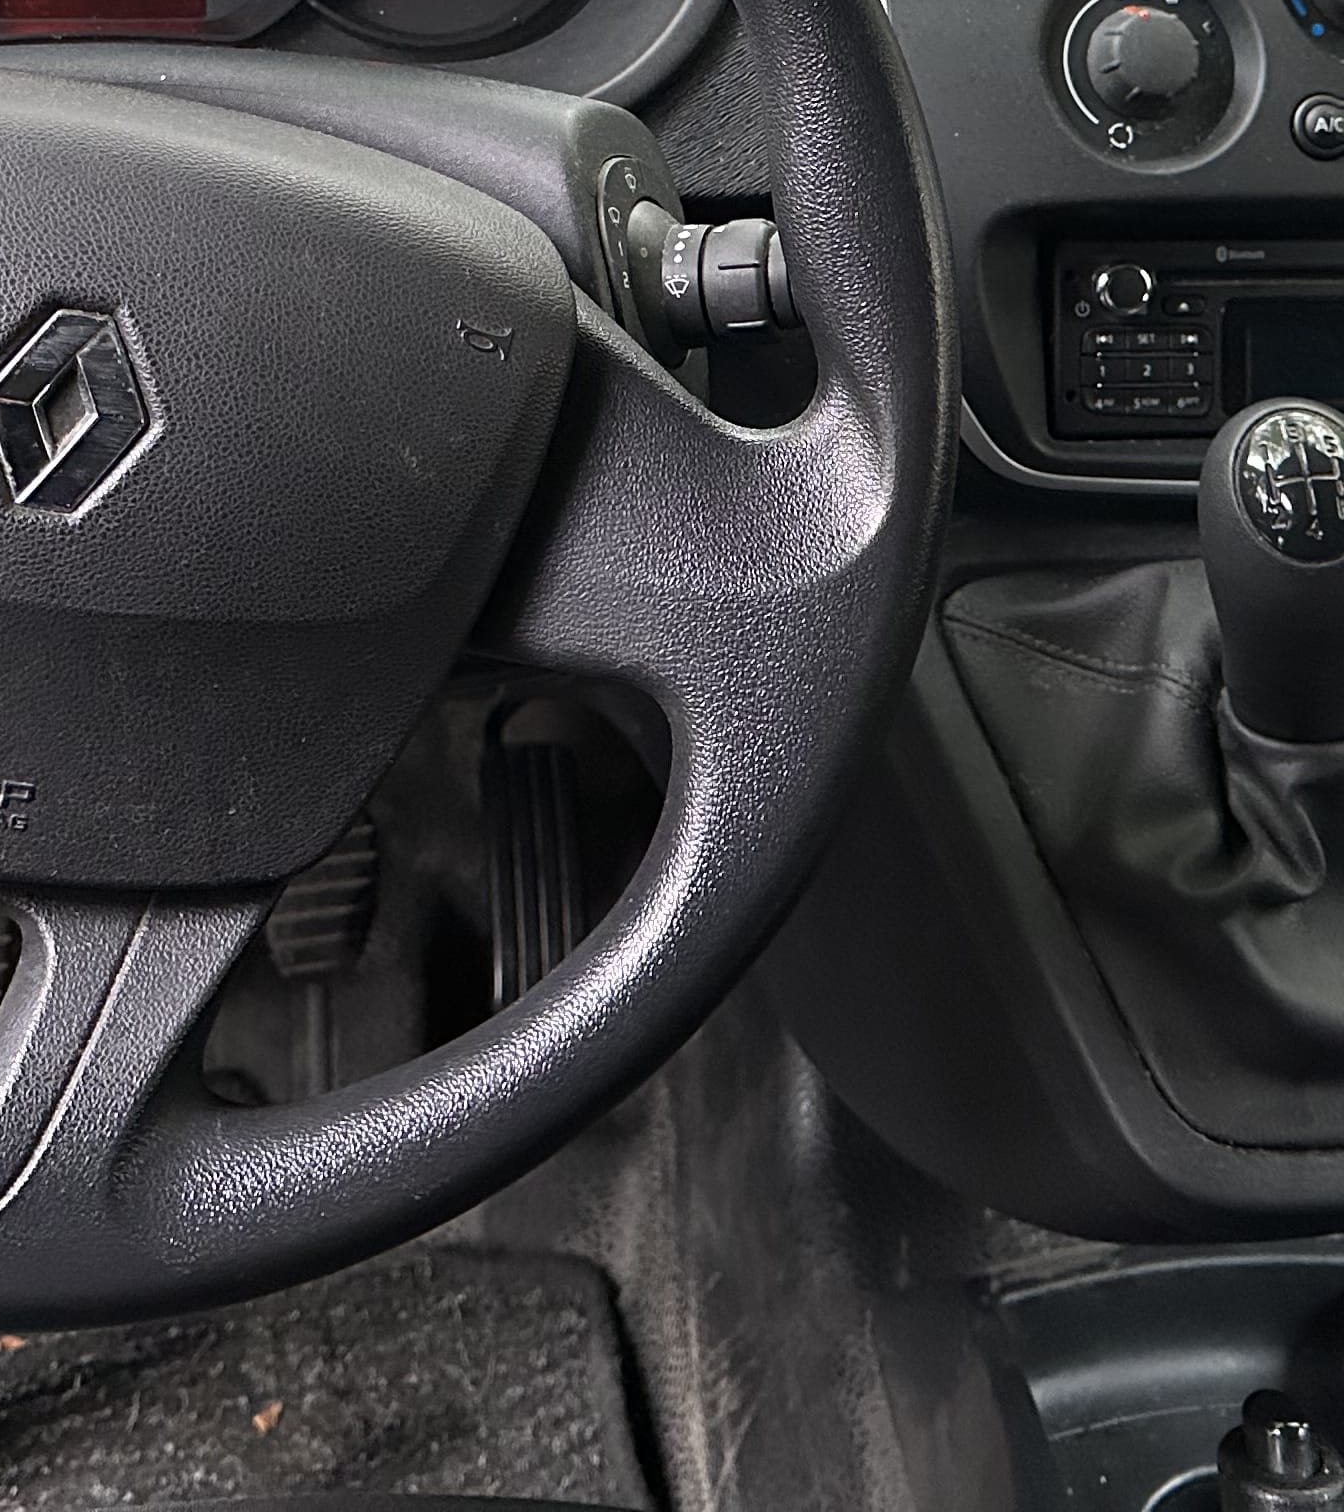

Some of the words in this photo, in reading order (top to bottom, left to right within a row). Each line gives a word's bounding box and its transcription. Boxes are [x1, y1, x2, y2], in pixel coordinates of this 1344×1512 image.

[1314, 116, 1344, 133] A/C
[622, 271, 630, 289] 2
[1142, 364, 1152, 377] 2
[1186, 363, 1195, 376] 3
[1323, 434, 1338, 454] 5
